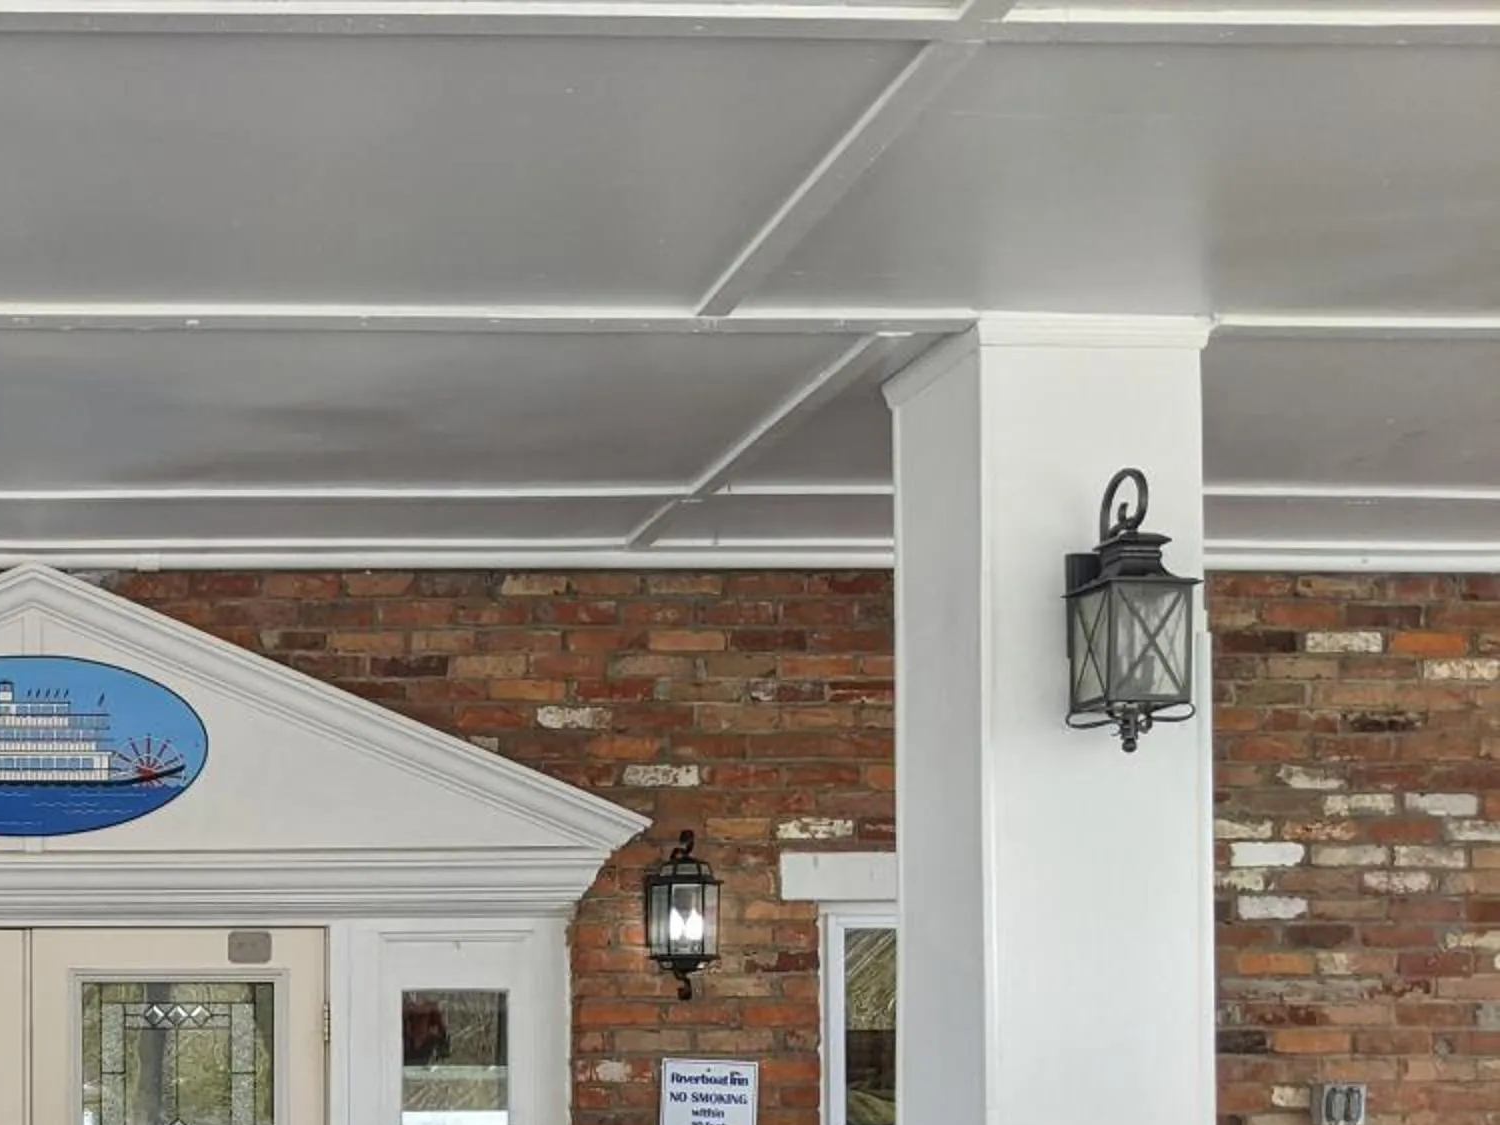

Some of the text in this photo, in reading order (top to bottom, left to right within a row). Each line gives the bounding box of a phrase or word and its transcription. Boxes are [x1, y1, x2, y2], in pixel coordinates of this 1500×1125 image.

[671, 1072, 728, 1086] Riverboat
[670, 1092, 748, 1104] NO SMOKING
[691, 1108, 725, 1118] within
